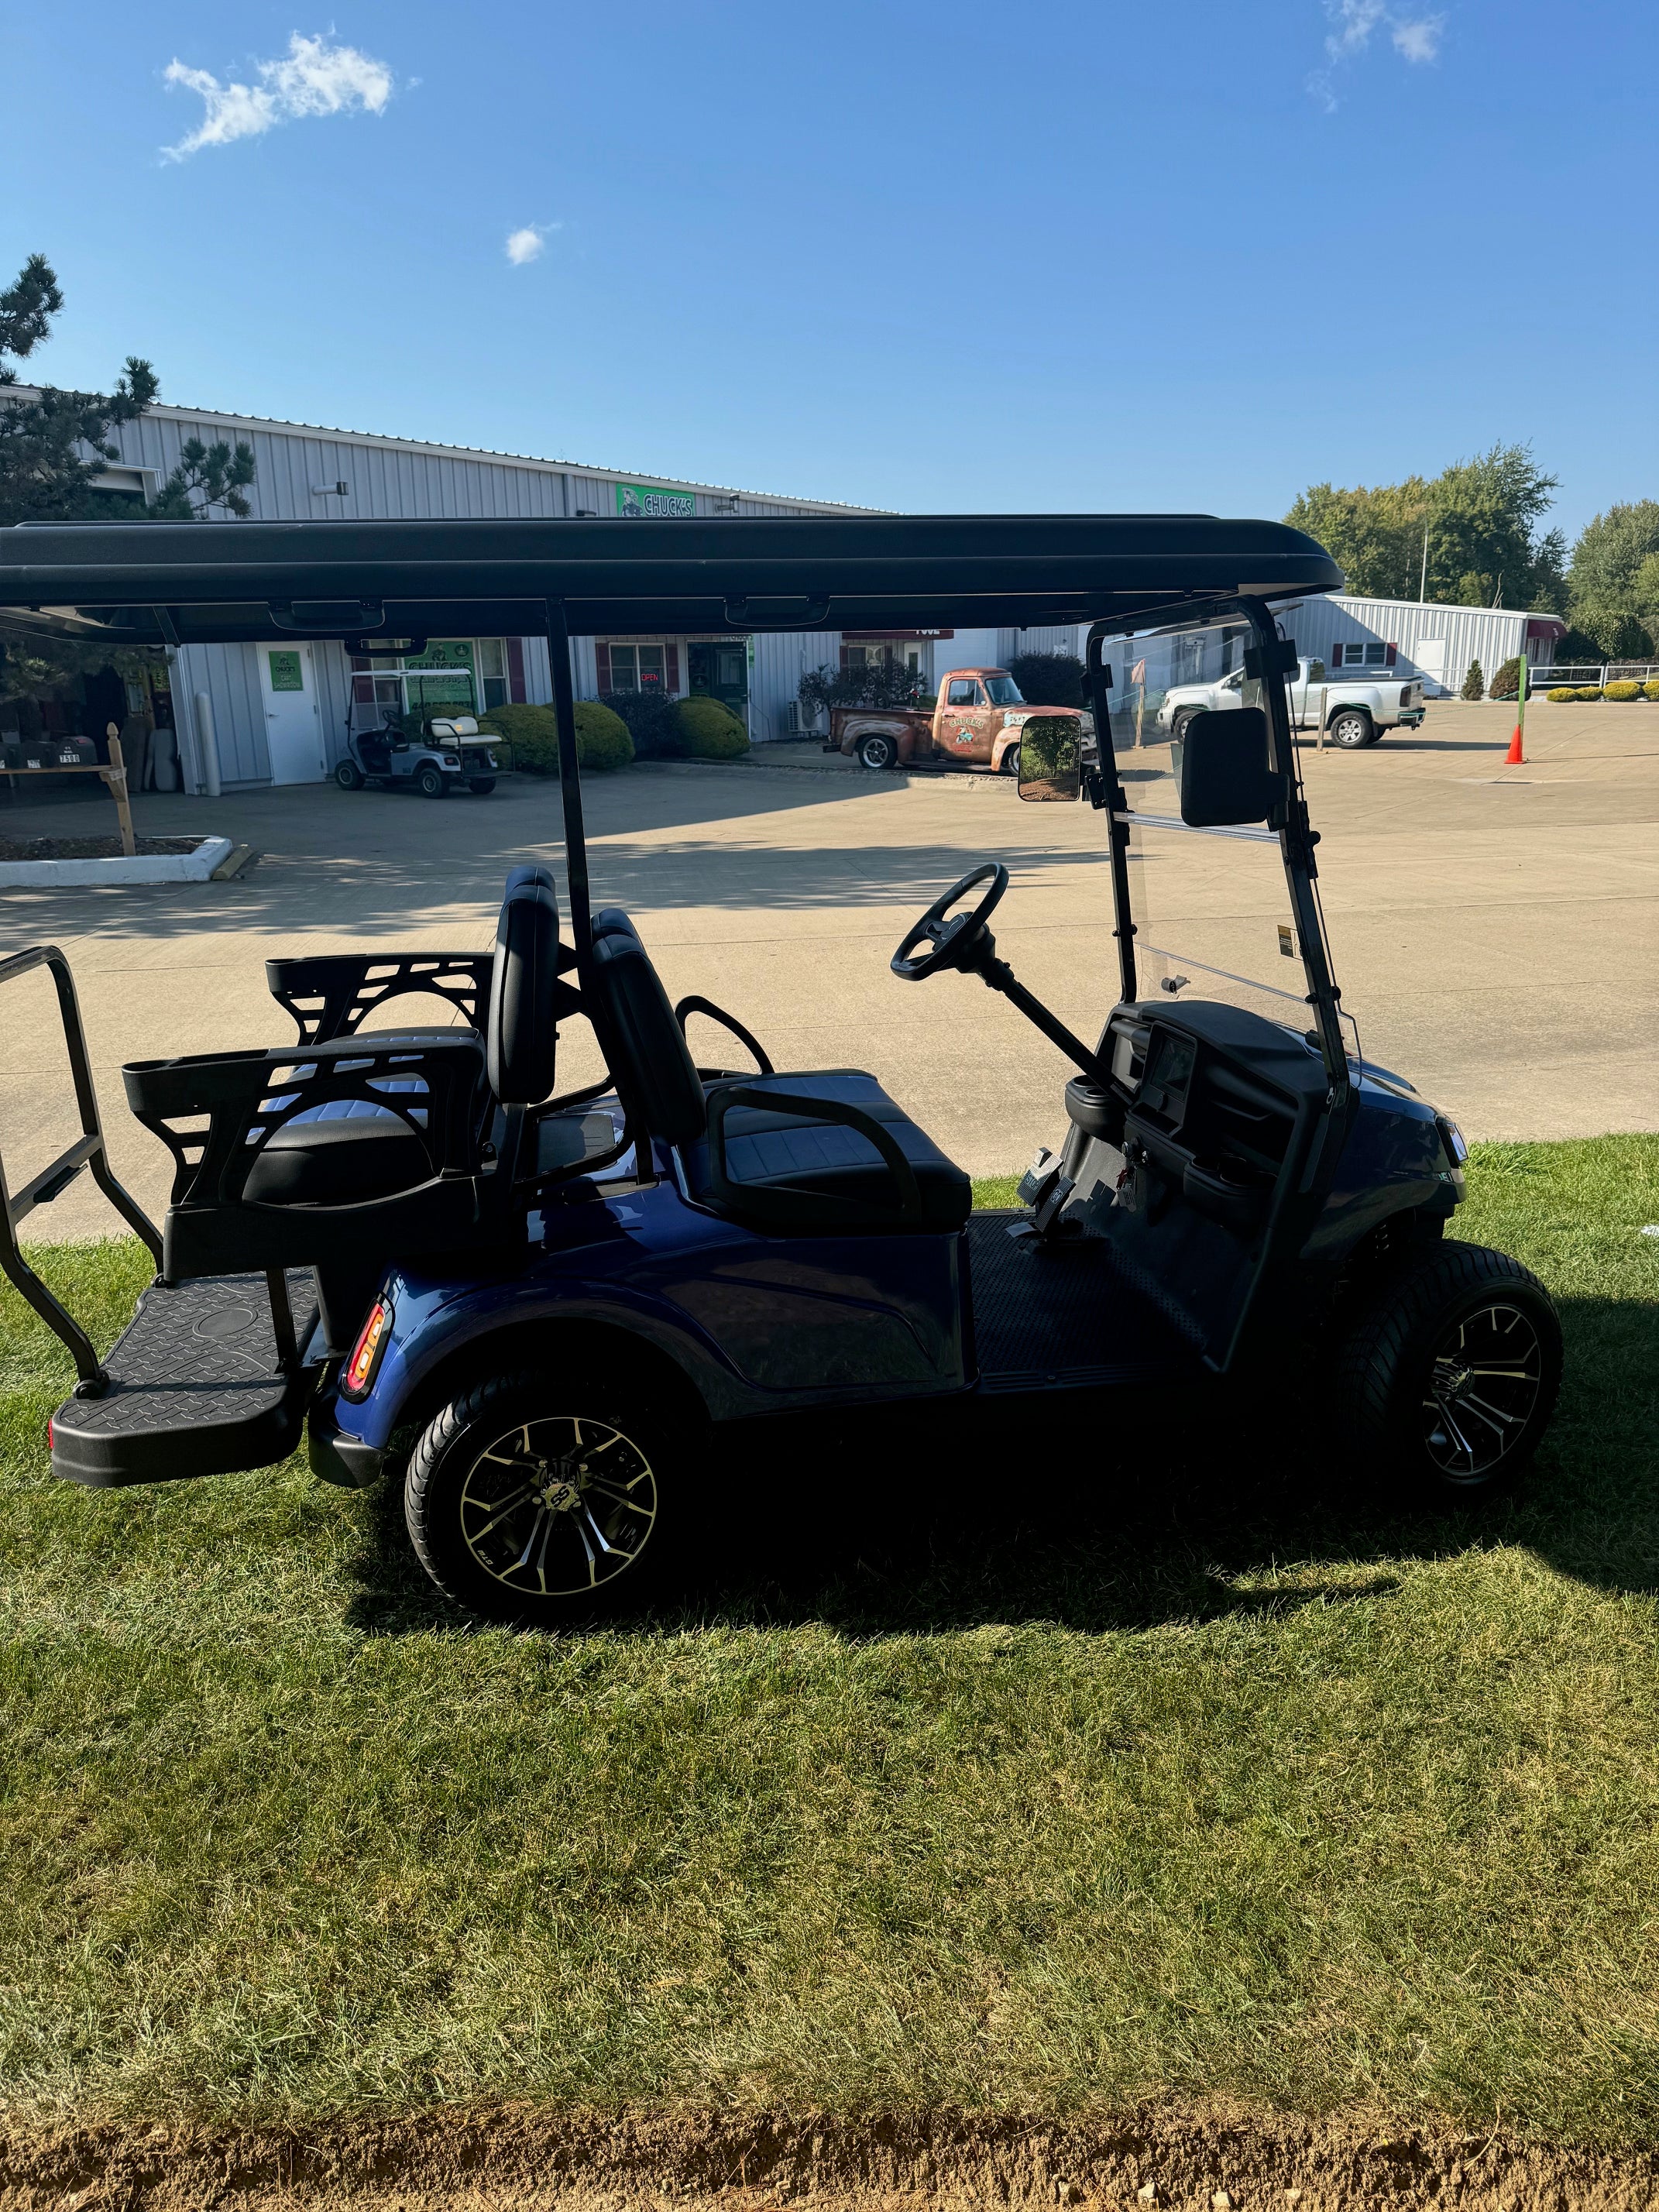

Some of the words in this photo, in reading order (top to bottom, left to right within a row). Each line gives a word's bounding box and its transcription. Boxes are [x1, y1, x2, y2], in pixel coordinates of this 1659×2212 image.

[644, 494, 692, 516] CHUCK'S
[949, 716, 984, 730] CHUCK'S
[1051, 1190, 1063, 1204] GO
[477, 1550, 494, 1565] GTW
